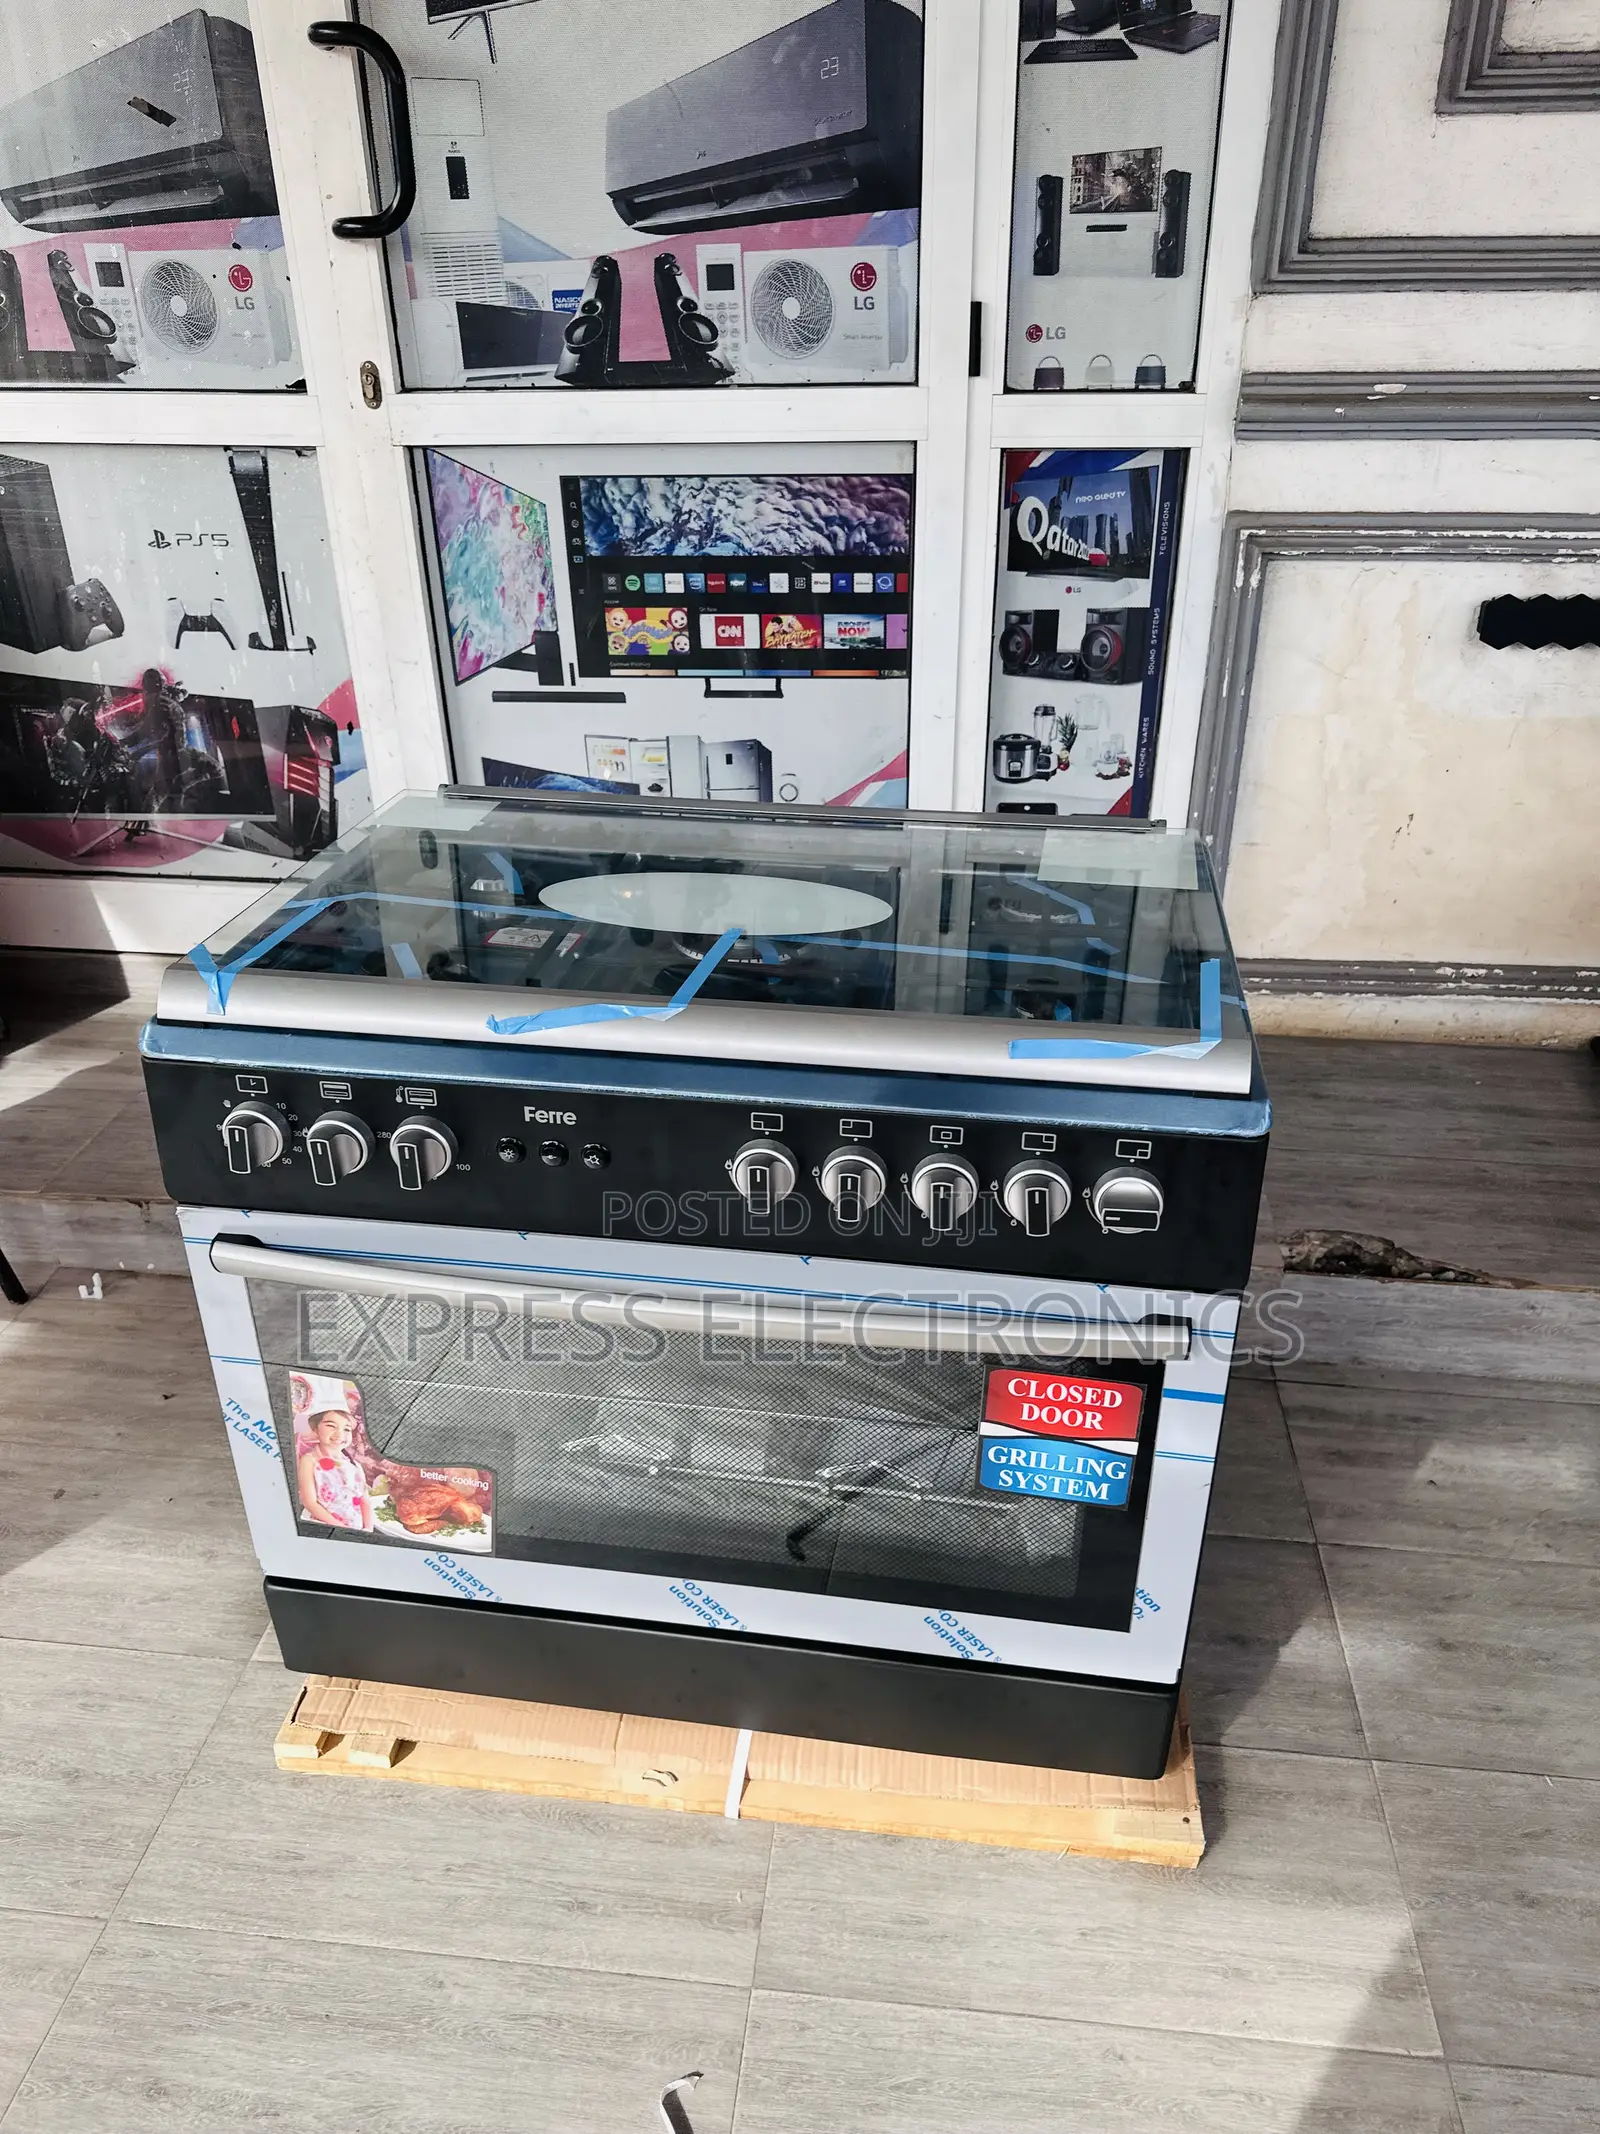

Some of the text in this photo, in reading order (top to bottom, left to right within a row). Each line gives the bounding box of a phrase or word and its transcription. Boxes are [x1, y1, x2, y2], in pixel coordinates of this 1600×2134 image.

[820, 57, 839, 79] 23
[234, 296, 255, 310] LG
[853, 296, 875, 310] LG
[1046, 326, 1066, 340] LG
[175, 533, 229, 546] PS5
[1158, 501, 1171, 556] TELEVISIONS
[717, 626, 743, 638] CNN
[1147, 607, 1161, 676] SOUND SYSTEMS
[1137, 716, 1150, 779] KITCHEN WARES
[276, 1102, 286, 1110] 10
[288, 1113, 298, 1121] 20
[523, 1105, 577, 1126] Ferre
[293, 1130, 302, 1138] 30
[376, 1131, 391, 1139] 280
[292, 1145, 302, 1153] 40
[282, 1157, 292, 1165] 50
[456, 1163, 471, 1171] 100
[1007, 1377, 1123, 1409] CLOSED
[226, 1397, 251, 1420] The
[1020, 1402, 1104, 1431] DOOR
[233, 1421, 274, 1454] LASER
[987, 1445, 1127, 1480] GRILLING
[420, 1468, 489, 1491] better cooking
[998, 1469, 1111, 1501] SYSTEM
[423, 1557, 476, 1600] Solution
[456, 1567, 495, 1598] LASER
[668, 1585, 720, 1628] Solution
[702, 1595, 740, 1626] LASER
[1136, 1586, 1161, 1612] tion
[923, 1615, 974, 1659] Solution
[956, 1627, 995, 1657] LASER
